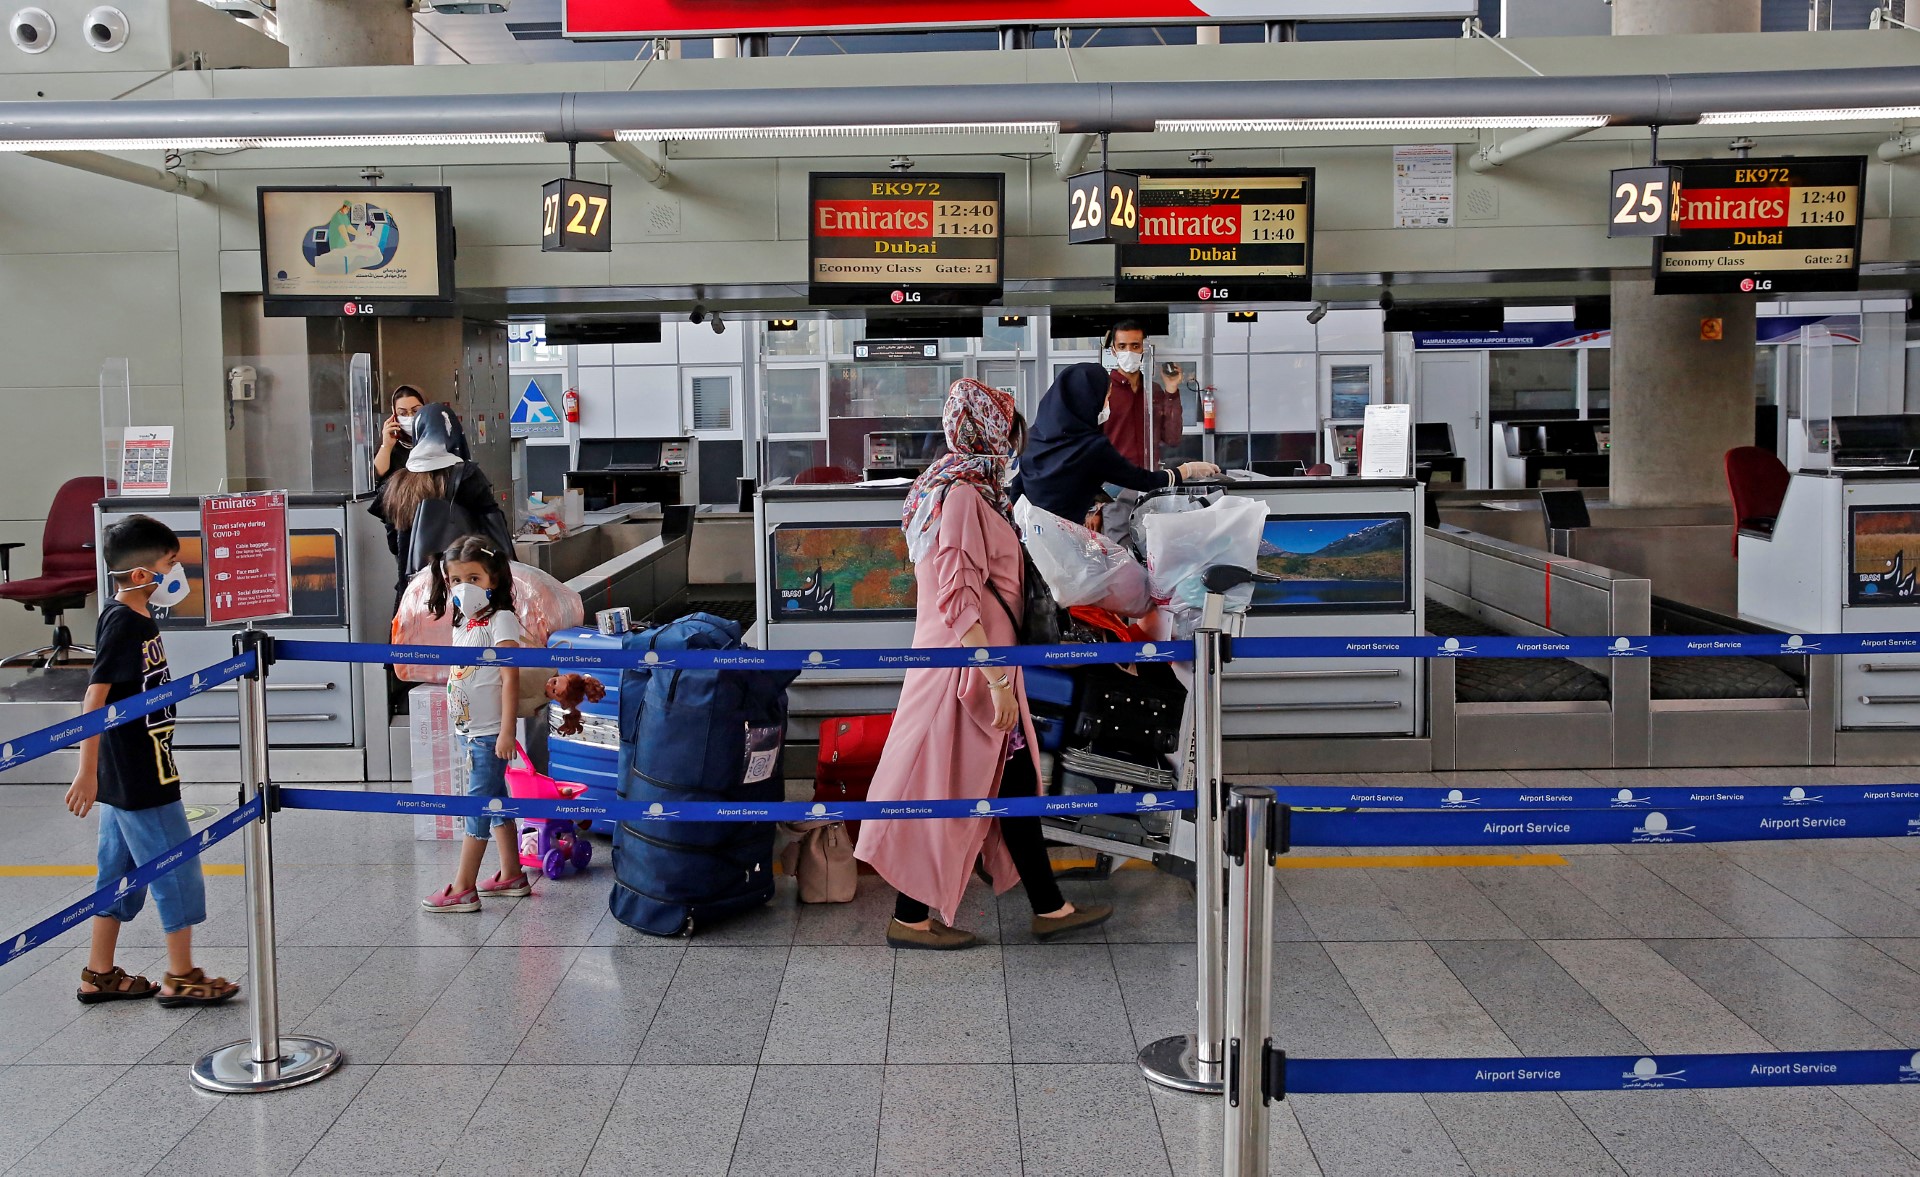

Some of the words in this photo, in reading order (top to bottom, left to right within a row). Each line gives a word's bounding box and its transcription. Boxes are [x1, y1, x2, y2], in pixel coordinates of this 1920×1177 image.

[1735, 168, 1790, 183] EK972
[871, 182, 941, 196] EK972
[1613, 182, 1663, 224] 25
[1671, 180, 1681, 222] 25
[1801, 191, 1846, 204] 12:40
[938, 204, 994, 217] 12:40
[1071, 186, 1102, 230] 26
[1110, 185, 1136, 229] 26
[544, 193, 560, 237] 27
[566, 193, 607, 236] 27
[818, 206, 929, 230] Emirates
[1252, 208, 1295, 221] 12:40
[1800, 210, 1845, 224] 11:40
[938, 223, 994, 235] 11:40
[1252, 228, 1295, 240] 11:40
[1733, 230, 1783, 245] Dubai
[874, 240, 938, 254] Dubai
[1189, 247, 1237, 261] Dubai
[1804, 255, 1833, 264] Gate:
[1835, 254, 1849, 263] 21
[1665, 257, 1714, 268] Economy
[1717, 256, 1745, 266] Class
[818, 263, 882, 274] Economy
[886, 263, 922, 273] Class
[935, 264, 971, 273] Gate:
[975, 264, 992, 273] 21
[1755, 280, 1772, 290] LG
[905, 292, 921, 302] LG
[1213, 288, 1229, 299] LG
[358, 304, 374, 314] LG
[211, 498, 257, 510] Emirates
[212, 530, 240, 538] COVID-19
[1859, 573, 1881, 582] IRAN
[1883, 556, 1914, 596] ایران
[781, 589, 802, 598] IRAN
[804, 572, 834, 612] ایران
[1346, 643, 1371, 651] Airport
[1516, 643, 1542, 652] Airport
[1542, 643, 1570, 651] Service
[1687, 641, 1713, 650] Airport
[1713, 641, 1742, 649] Service
[1861, 639, 1887, 648] Airport
[1888, 638, 1917, 646] Service
[390, 651, 413, 659] Airport
[414, 651, 440, 659] Service
[550, 655, 574, 663] Airport
[575, 655, 602, 663] Service
[713, 656, 738, 665] Airport
[738, 656, 765, 664] Service
[878, 655, 907, 663] Airport
[1044, 651, 1070, 659] Airport
[223, 665, 235, 675] Airport
[235, 661, 247, 670] Service
[145, 695, 159, 706] Airport
[159, 690, 173, 701] Service
[49, 728, 66, 742] Airport
[66, 724, 83, 737] Service
[1350, 794, 1376, 802] Airport
[1376, 794, 1404, 802] Service
[1519, 794, 1545, 803] Airport
[1545, 794, 1573, 802] Service
[1690, 793, 1716, 802] Airport
[1716, 793, 1745, 801] Service
[1863, 792, 1890, 800] Airport
[1890, 791, 1919, 799] Service
[396, 800, 420, 808] Airport
[420, 800, 446, 809] Service
[555, 805, 580, 814] Airport
[580, 806, 607, 814] Service
[1045, 802, 1071, 810] Airport
[1071, 801, 1098, 809] Service
[232, 812, 244, 825] Airport
[243, 807, 256, 819] Service
[716, 808, 741, 816] Airport
[880, 807, 905, 815] Airport
[1483, 823, 1524, 835] Airport
[1526, 822, 1571, 833] Service
[1759, 818, 1800, 830] Airport
[1802, 816, 1846, 828] Service
[156, 857, 170, 870] Airport
[168, 851, 183, 864] Service
[61, 911, 79, 925] Airport
[78, 902, 95, 916] Service
[1475, 1070, 1515, 1082] Airport
[1517, 1069, 1561, 1080] Service
[1750, 1064, 1791, 1076] Airport
[1793, 1063, 1837, 1074] Service
